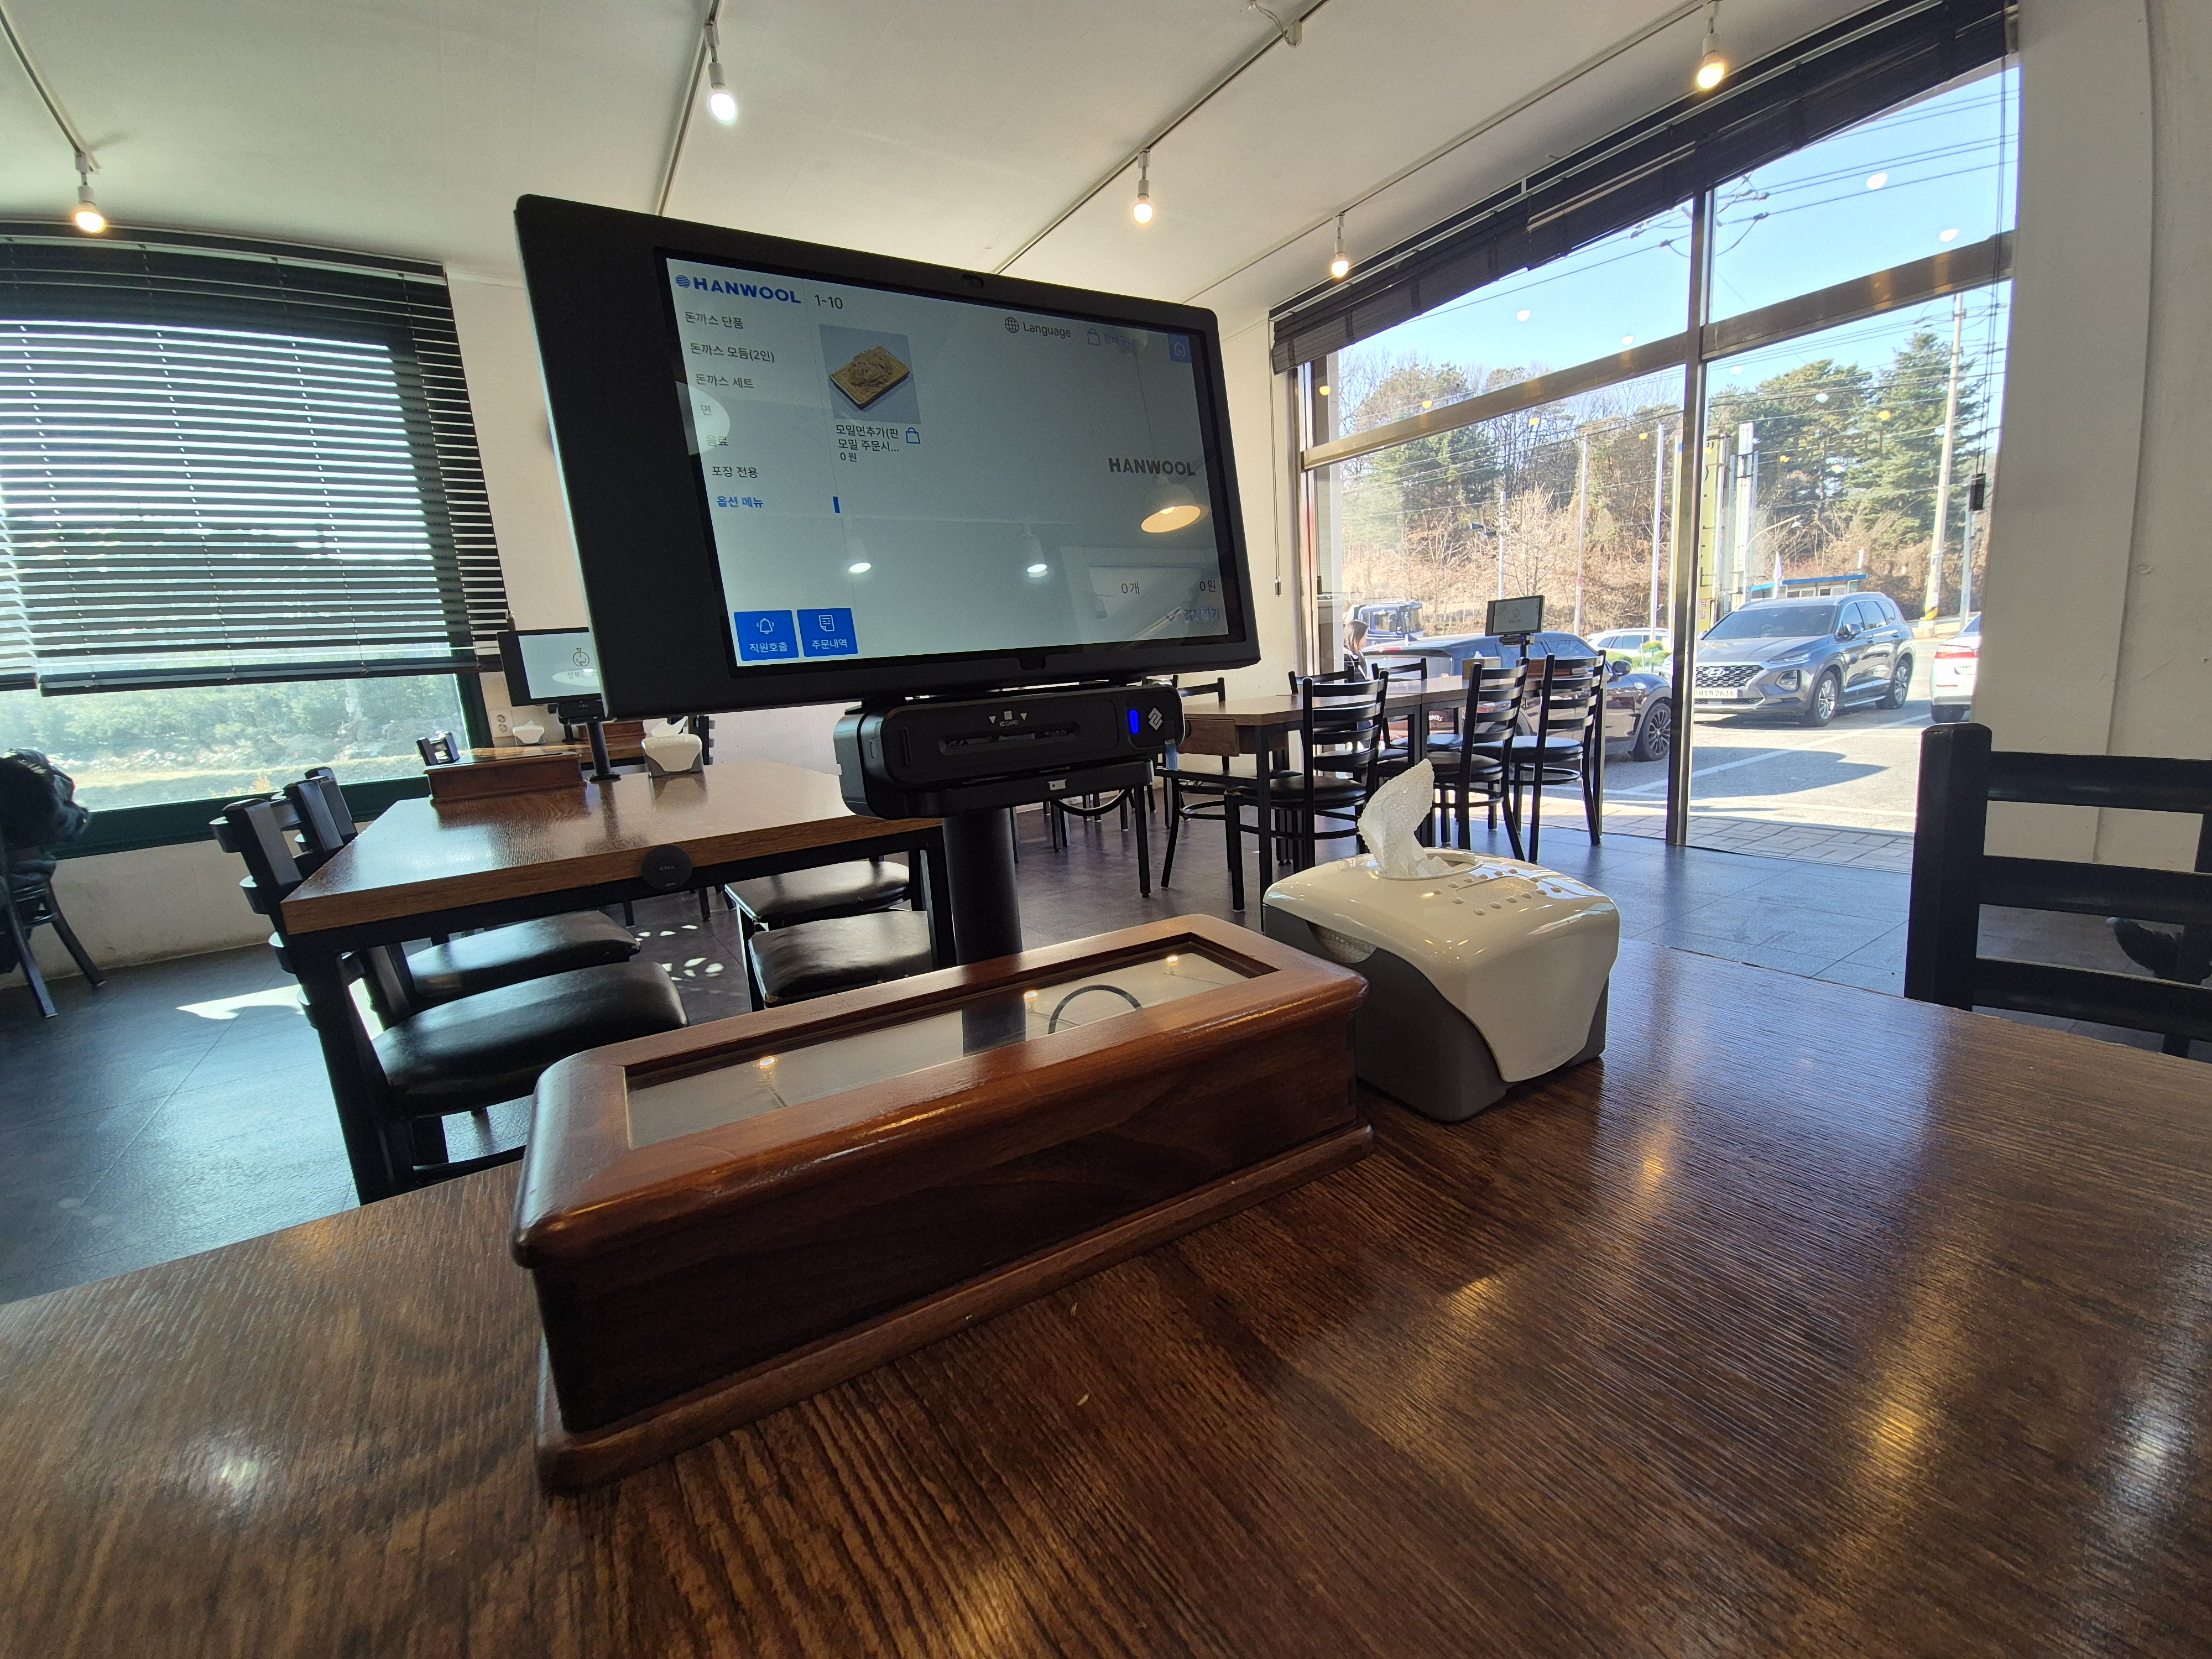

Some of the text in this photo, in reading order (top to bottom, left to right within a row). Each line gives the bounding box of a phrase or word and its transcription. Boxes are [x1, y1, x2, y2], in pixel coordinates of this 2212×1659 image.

[693, 277, 801, 304] HANWOOL
[815, 294, 843, 309] 1-10
[685, 311, 744, 329] 돈까스 단품
[1023, 321, 1071, 339] Language
[690, 343, 775, 363] 돈까스 모듬(2인)
[696, 374, 754, 388] 돈까스 세트
[700, 404, 712, 416] 면
[836, 425, 899, 440] 모밀면추가(판
[706, 435, 729, 447] 음료
[838, 439, 858, 450] 모밀
[712, 466, 759, 478] 포장 전용
[1108, 457, 1196, 476] HANWOOL
[717, 495, 764, 508] 옵션 메뉴
[1184, 607, 1220, 621] 결제하기
[749, 638, 848, 653] 직원호출 주문내역
